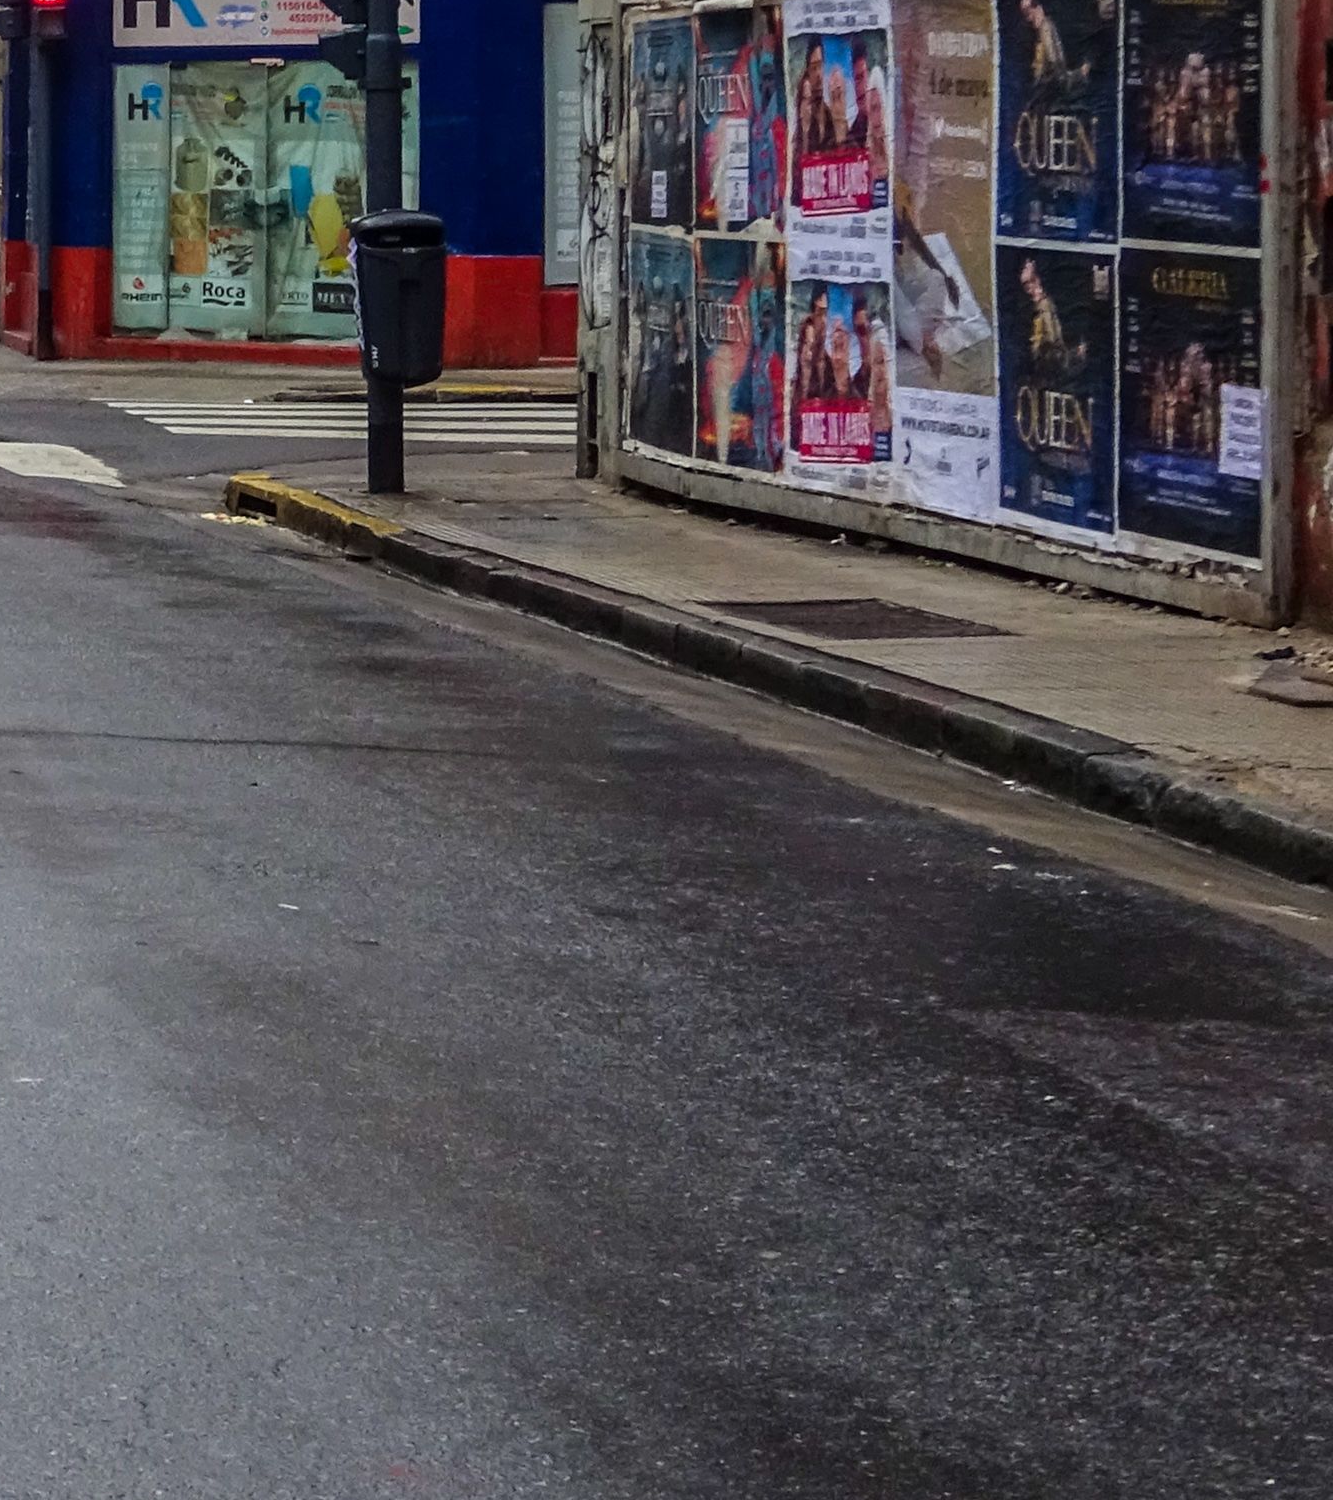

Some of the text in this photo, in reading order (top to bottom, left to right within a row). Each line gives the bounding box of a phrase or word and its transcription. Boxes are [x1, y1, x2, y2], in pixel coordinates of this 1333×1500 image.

[698, 73, 750, 125] QUEEN
[1014, 111, 1098, 177] QUEEN
[202, 281, 246, 299] Roca
